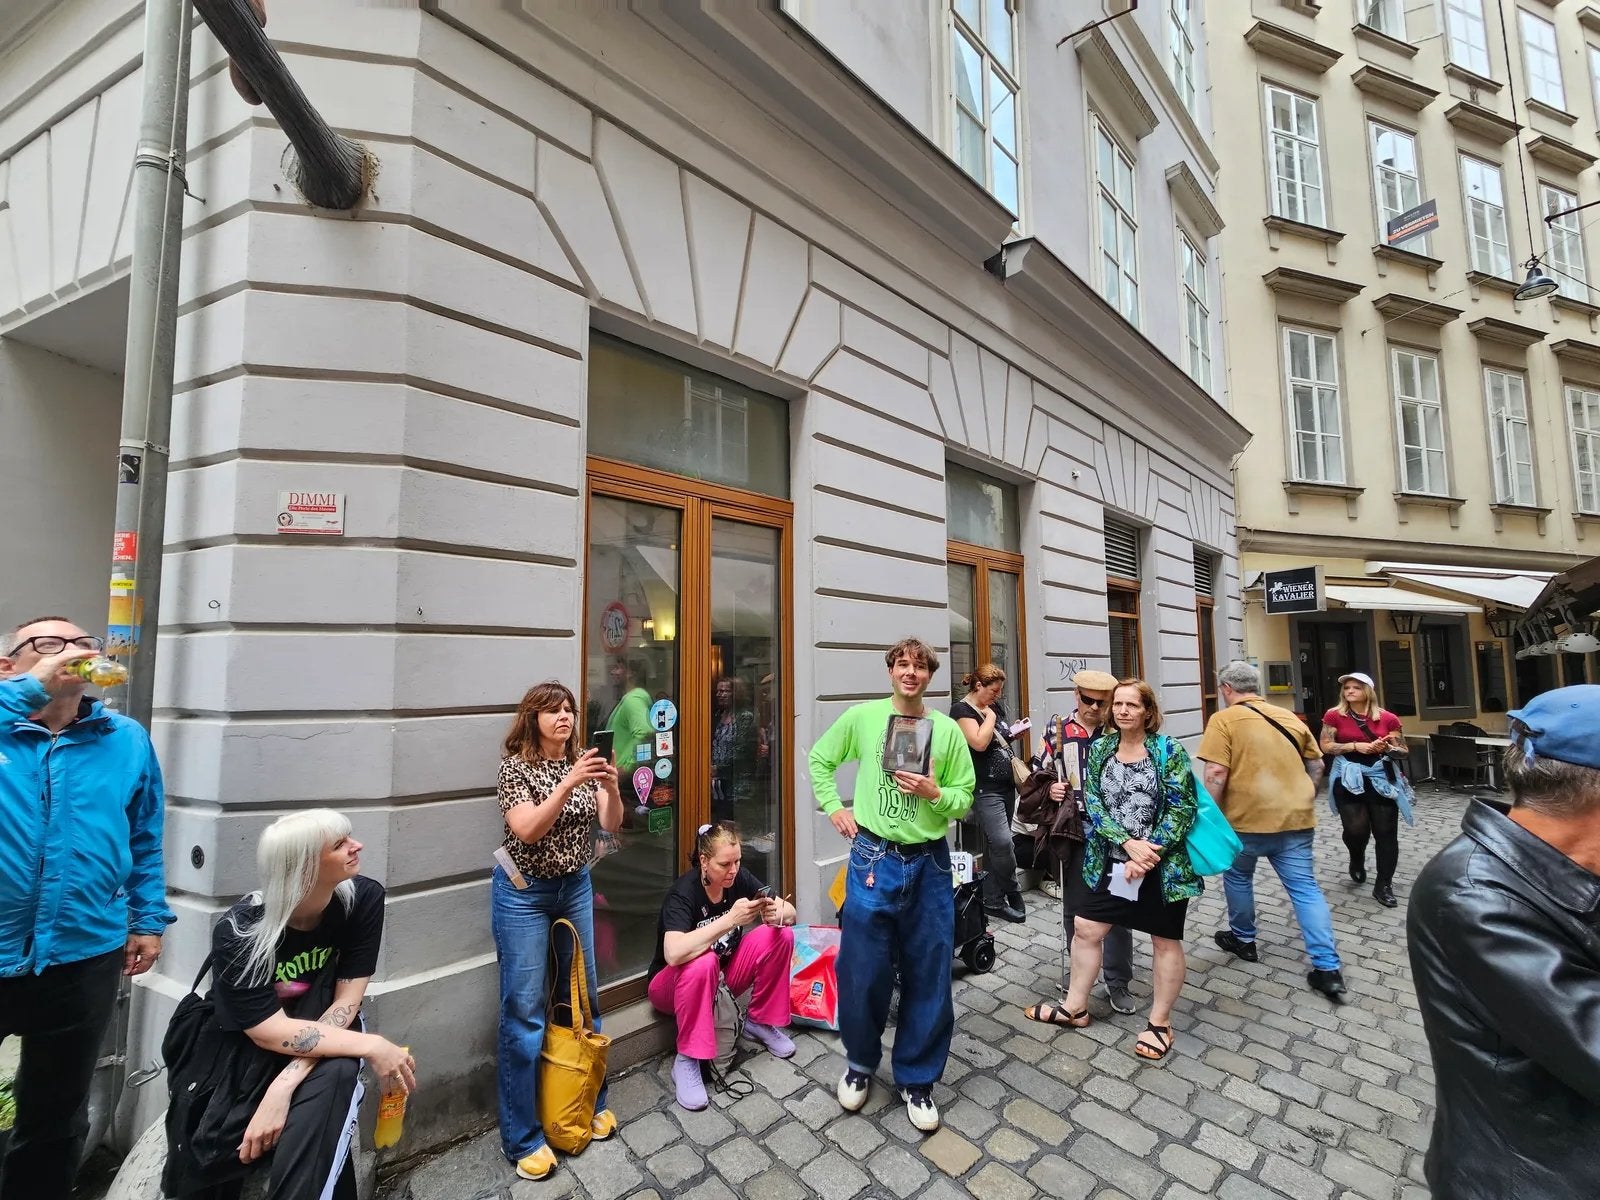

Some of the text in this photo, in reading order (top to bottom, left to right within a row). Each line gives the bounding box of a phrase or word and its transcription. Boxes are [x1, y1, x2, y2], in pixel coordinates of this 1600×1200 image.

[288, 492, 337, 506] DIMMI
[1282, 583, 1315, 593] WIENER
[1272, 590, 1315, 602] KAVALIER
